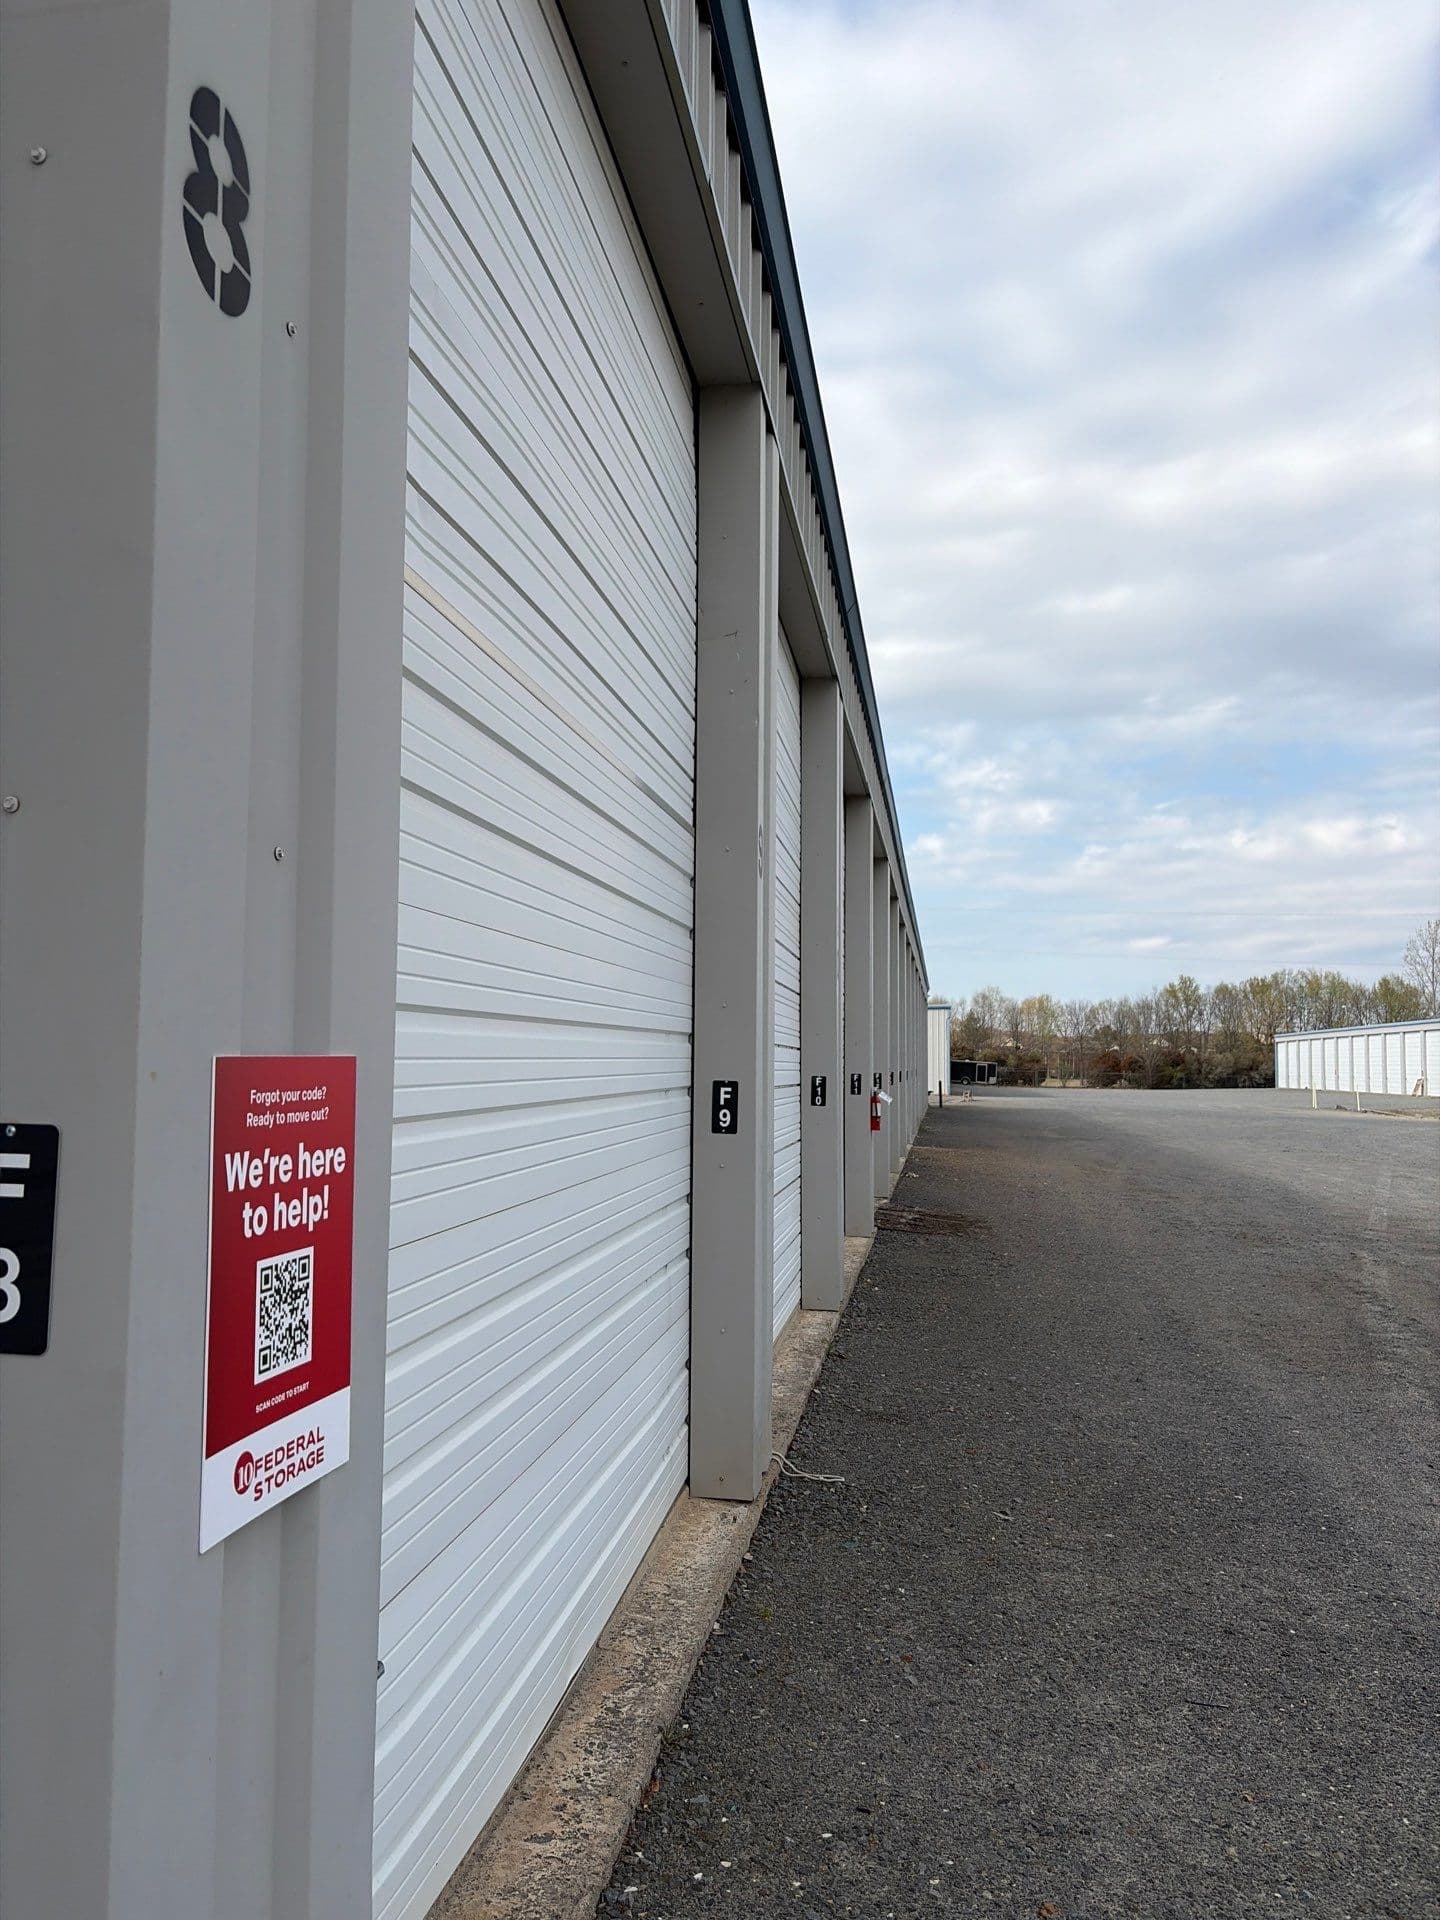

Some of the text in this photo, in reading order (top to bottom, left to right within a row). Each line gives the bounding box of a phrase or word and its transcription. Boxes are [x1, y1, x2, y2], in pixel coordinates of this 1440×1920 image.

[183, 86, 251, 317] 8
[246, 1106, 329, 1128] Ready to move out?
[250, 1086, 327, 1106] Forgot your code?
[225, 1142, 346, 1192] We're here
[243, 1184, 329, 1238] to help!
[255, 1381, 310, 1414] SCAN CODE TO START
[237, 1426, 325, 1491] 10 FEDERAL
[253, 1445, 325, 1502] STORAGE
